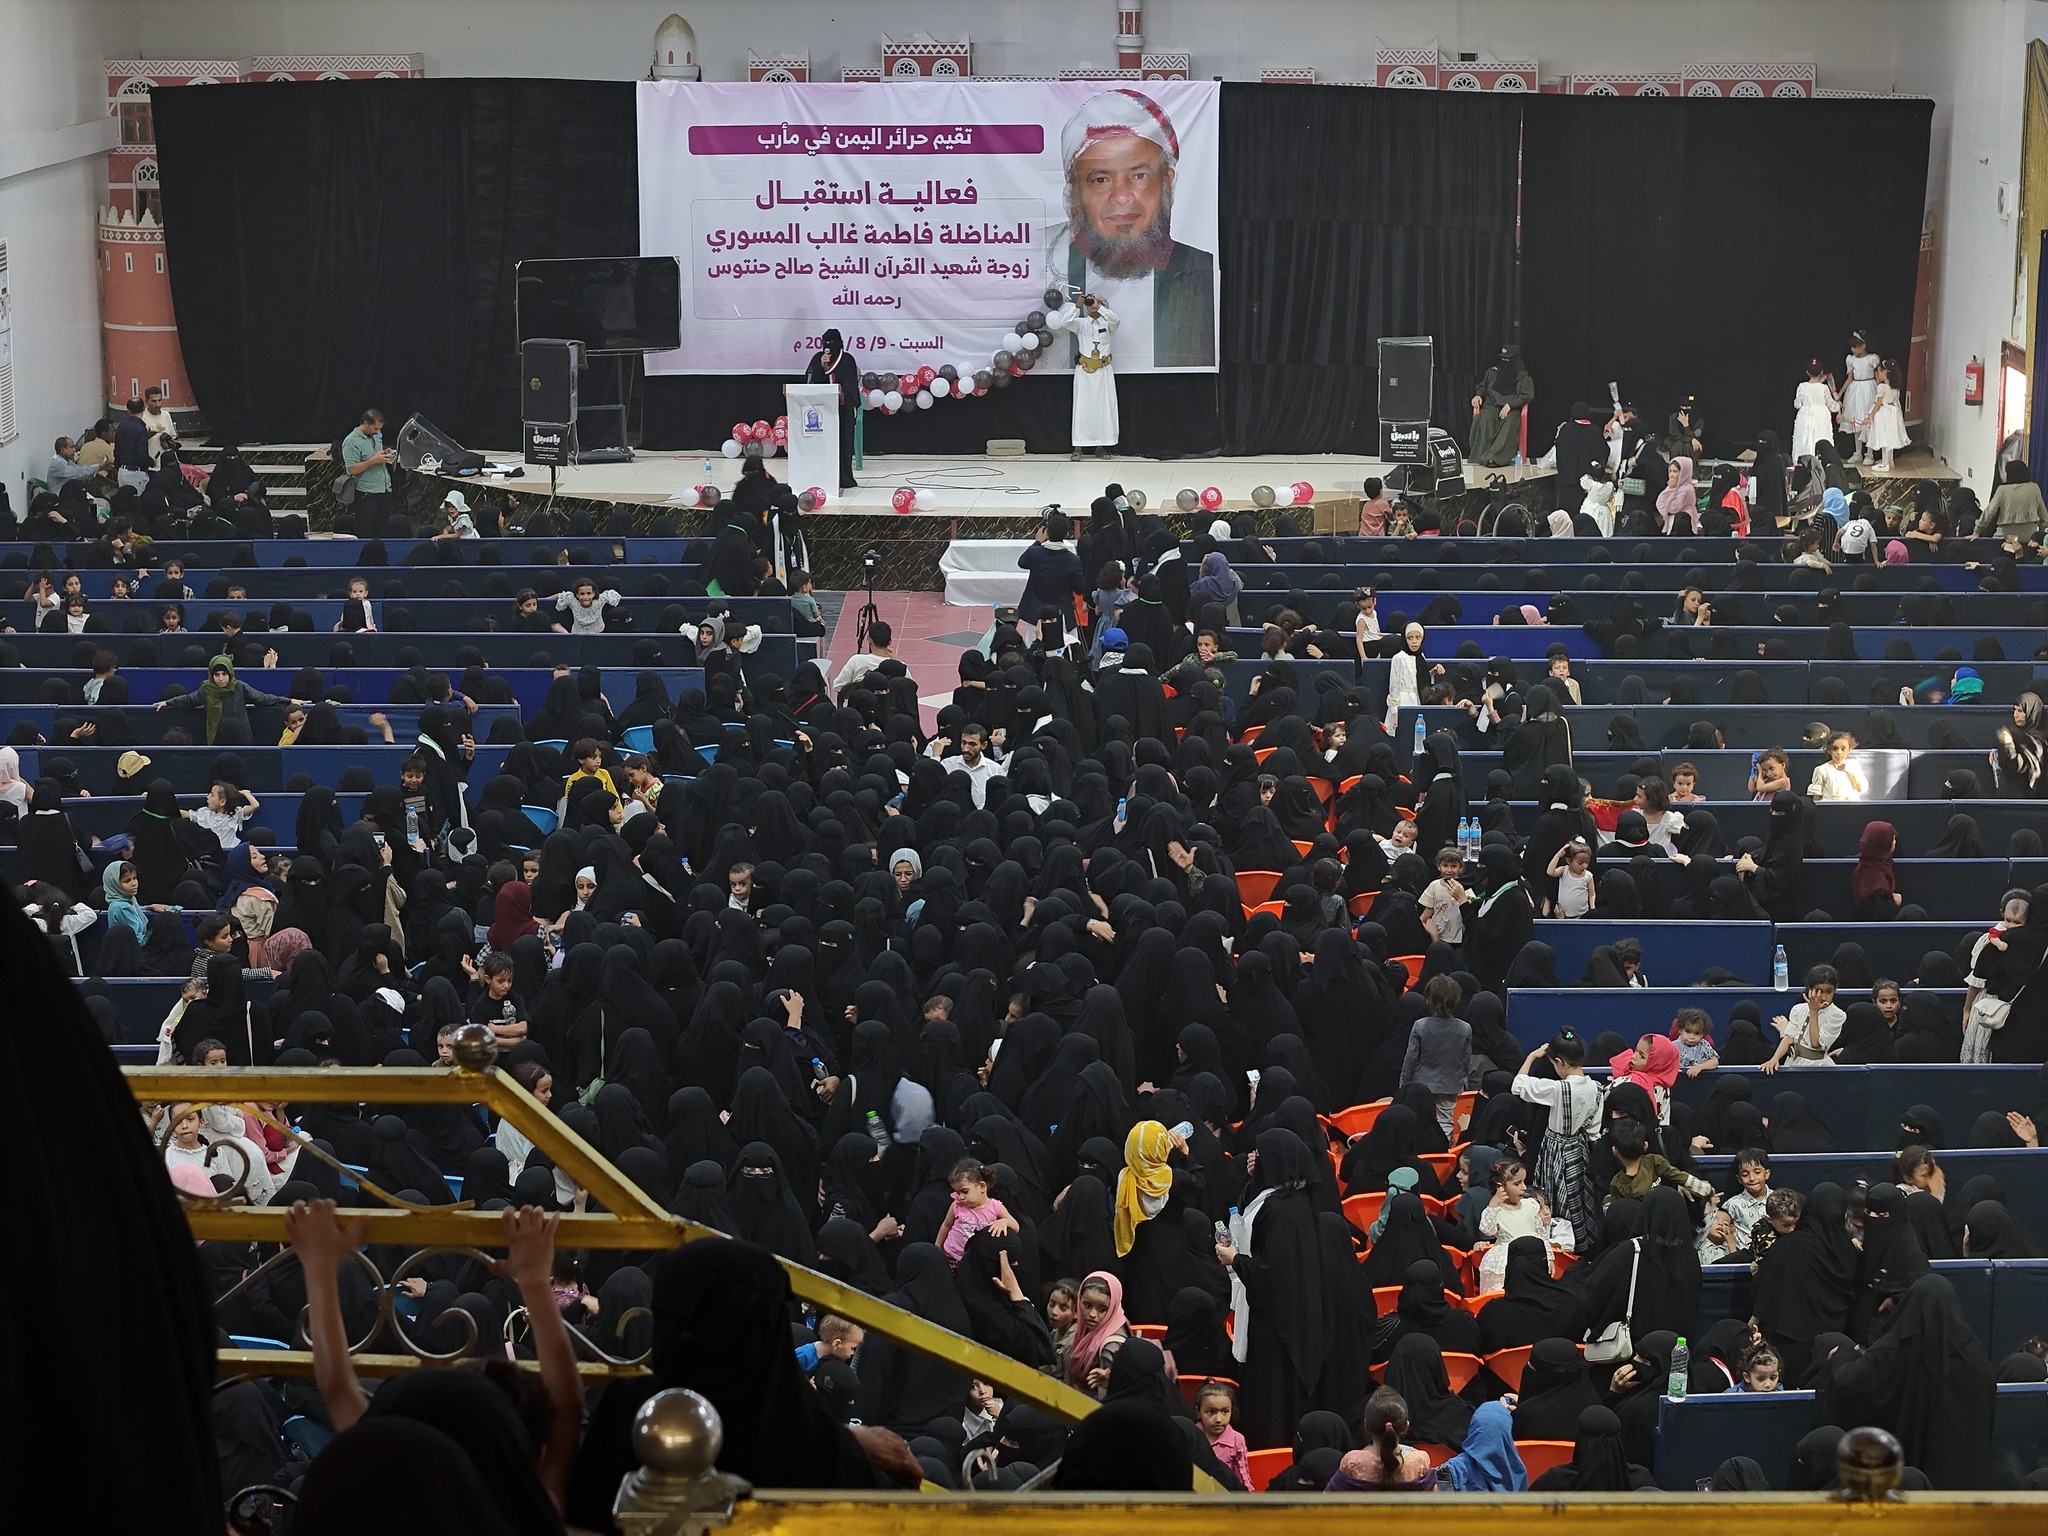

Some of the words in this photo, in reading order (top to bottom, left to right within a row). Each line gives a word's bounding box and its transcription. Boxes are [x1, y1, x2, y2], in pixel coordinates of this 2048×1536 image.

[757, 122, 800, 149] مأرب
[804, 125, 831, 157] في
[835, 127, 882, 150] اليمن
[885, 128, 929, 150] حرائر
[932, 128, 973, 150] تقيم
[756, 180, 871, 211] استقبال
[878, 178, 978, 212] فعالية
[706, 222, 801, 254] المسوري
[806, 222, 859, 251] غالب
[863, 221, 934, 245] فاطمة
[939, 222, 1030, 245] المناضلة
[707, 258, 771, 280] حنتوس
[774, 257, 814, 280] صالح
[818, 255, 870, 280] الشيخ
[874, 255, 925, 280] القرآن
[930, 255, 983, 280] شهيد
[986, 257, 1030, 279] زوجة
[832, 284, 860, 306] الله
[863, 294, 902, 310] رحمه
[855, 336, 866, 350] 8
[899, 335, 944, 353] السبت
[1850, 525, 1864, 538] 9
